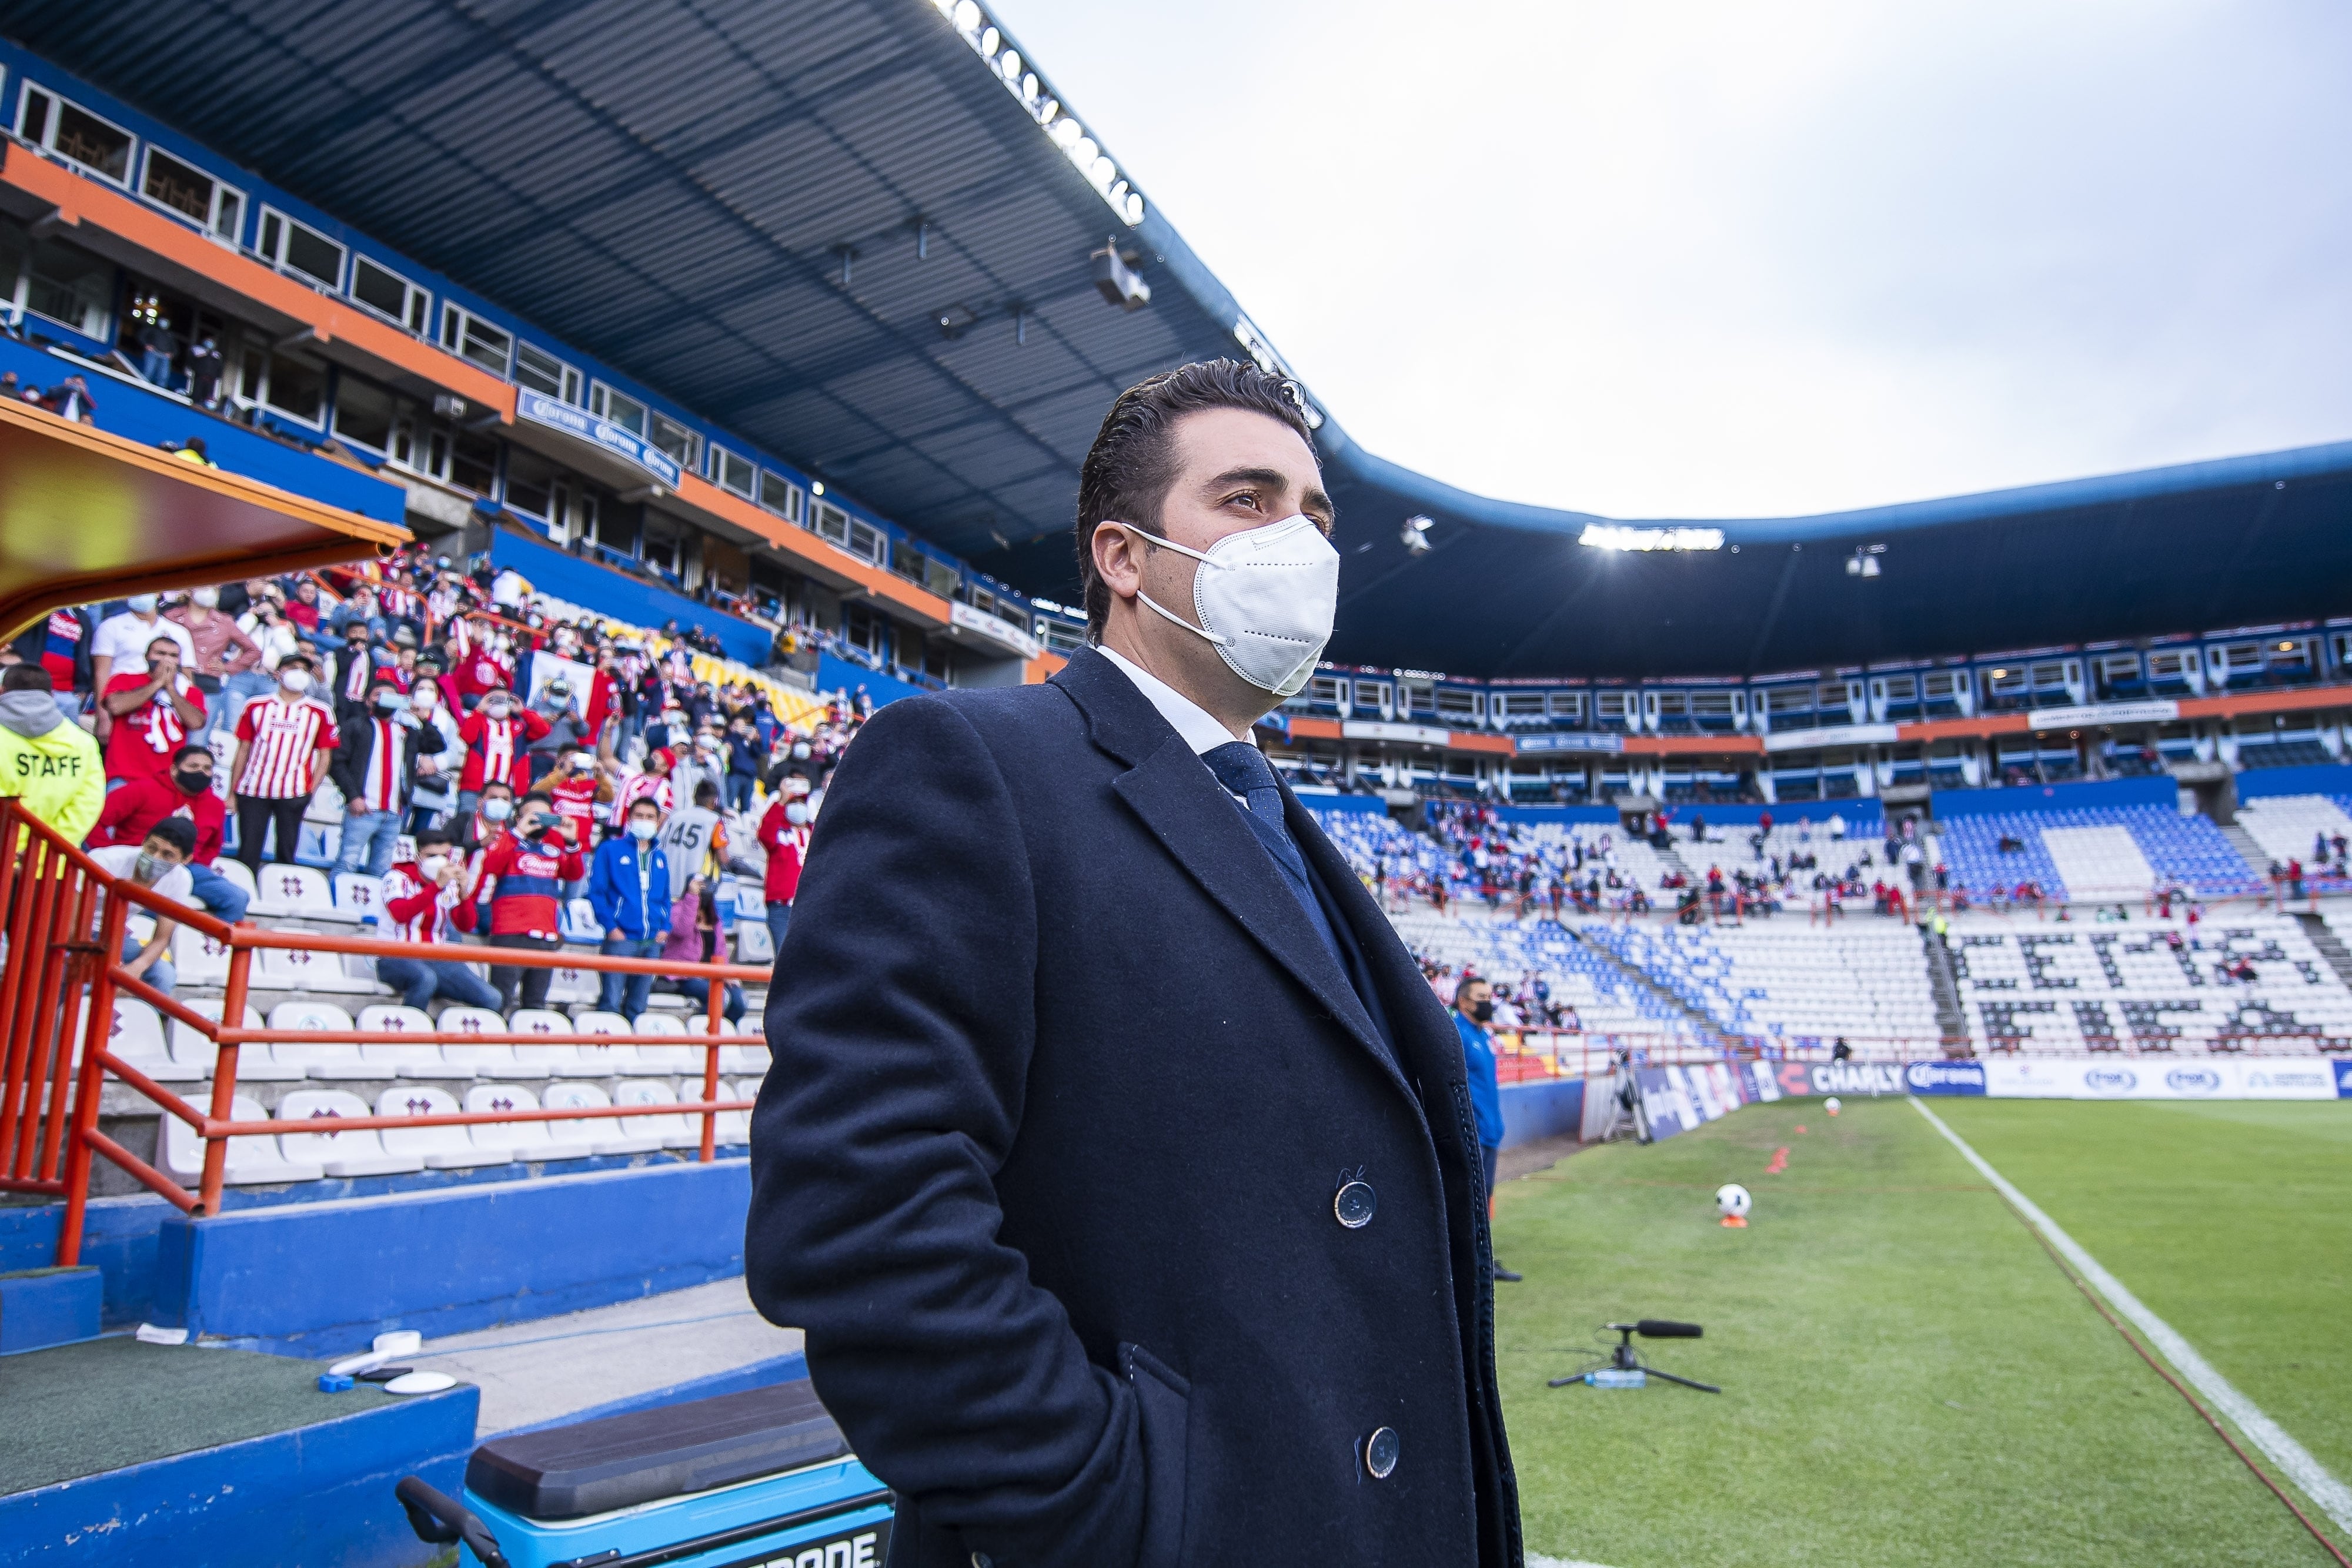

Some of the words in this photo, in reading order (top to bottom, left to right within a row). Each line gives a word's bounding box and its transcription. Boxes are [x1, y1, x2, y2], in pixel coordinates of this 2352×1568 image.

[533, 399, 587, 430] Corona
[594, 424, 640, 454] Corona
[17, 753, 81, 777] STAFF
[1812, 1065, 1904, 1092] CHARLY
